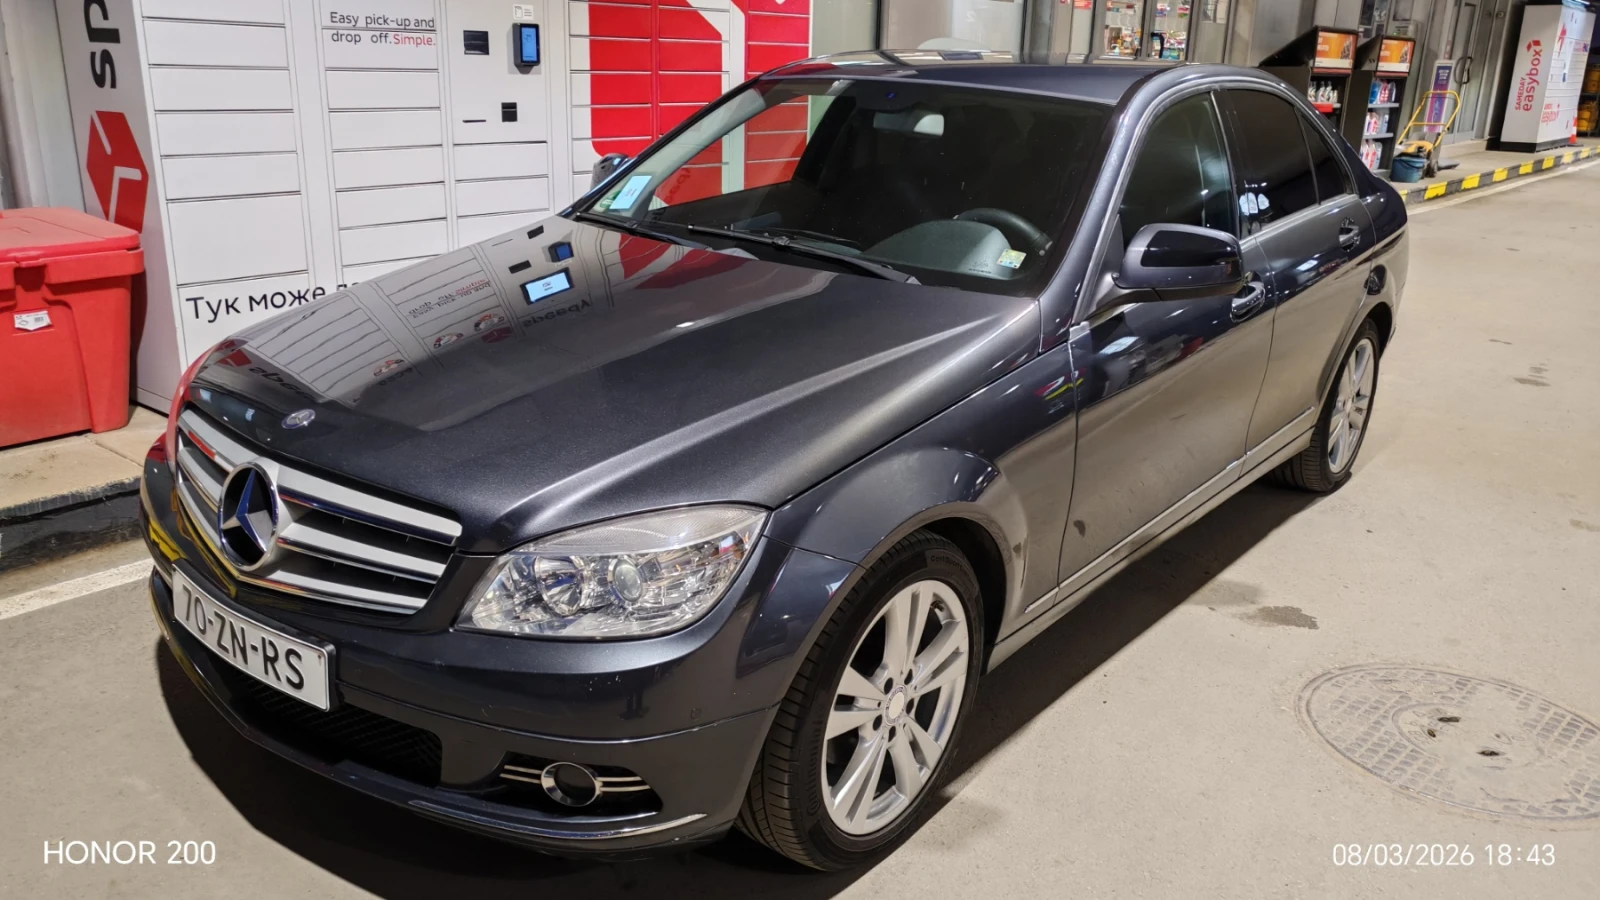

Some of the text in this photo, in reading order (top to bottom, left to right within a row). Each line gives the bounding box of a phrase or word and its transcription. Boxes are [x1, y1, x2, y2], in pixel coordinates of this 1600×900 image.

[330, 11, 435, 30] Easy pick-up and
[331, 31, 436, 47] drop off. Simple.
[1515, 77, 1526, 110] SAMEDAY
[1522, 48, 1543, 112] easybox
[185, 286, 326, 323] Тук може
[183, 583, 305, 690] 70-ZN-RS
